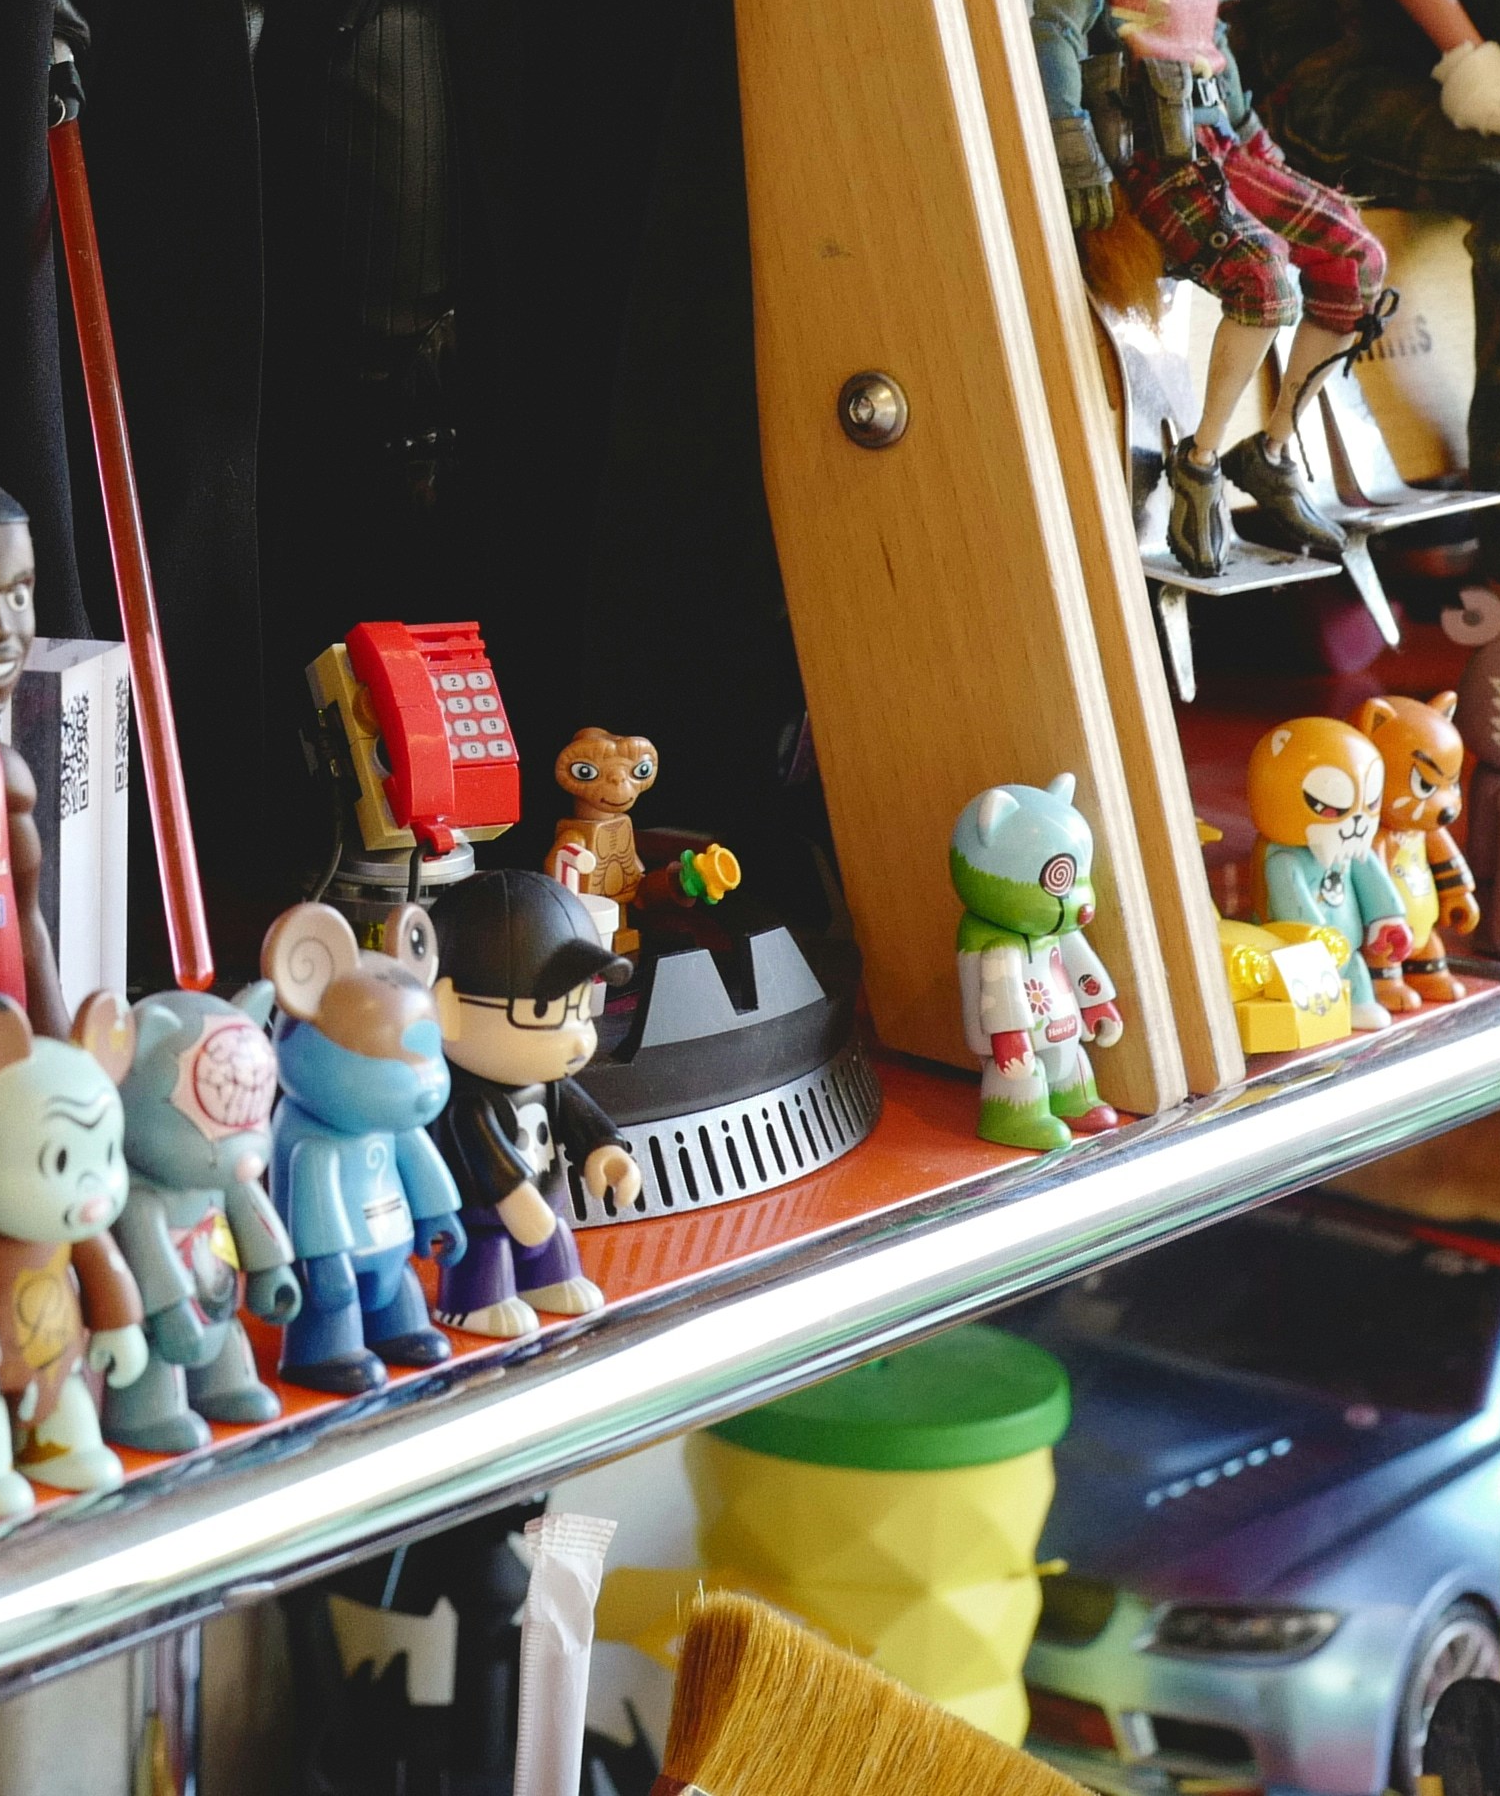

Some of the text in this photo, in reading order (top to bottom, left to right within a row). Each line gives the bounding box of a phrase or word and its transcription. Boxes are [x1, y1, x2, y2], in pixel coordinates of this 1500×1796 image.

[449, 675, 484, 687] 2 3
[455, 699, 464, 709] 5
[463, 720, 497, 732] 8 9
[470, 745, 478, 754] 0
